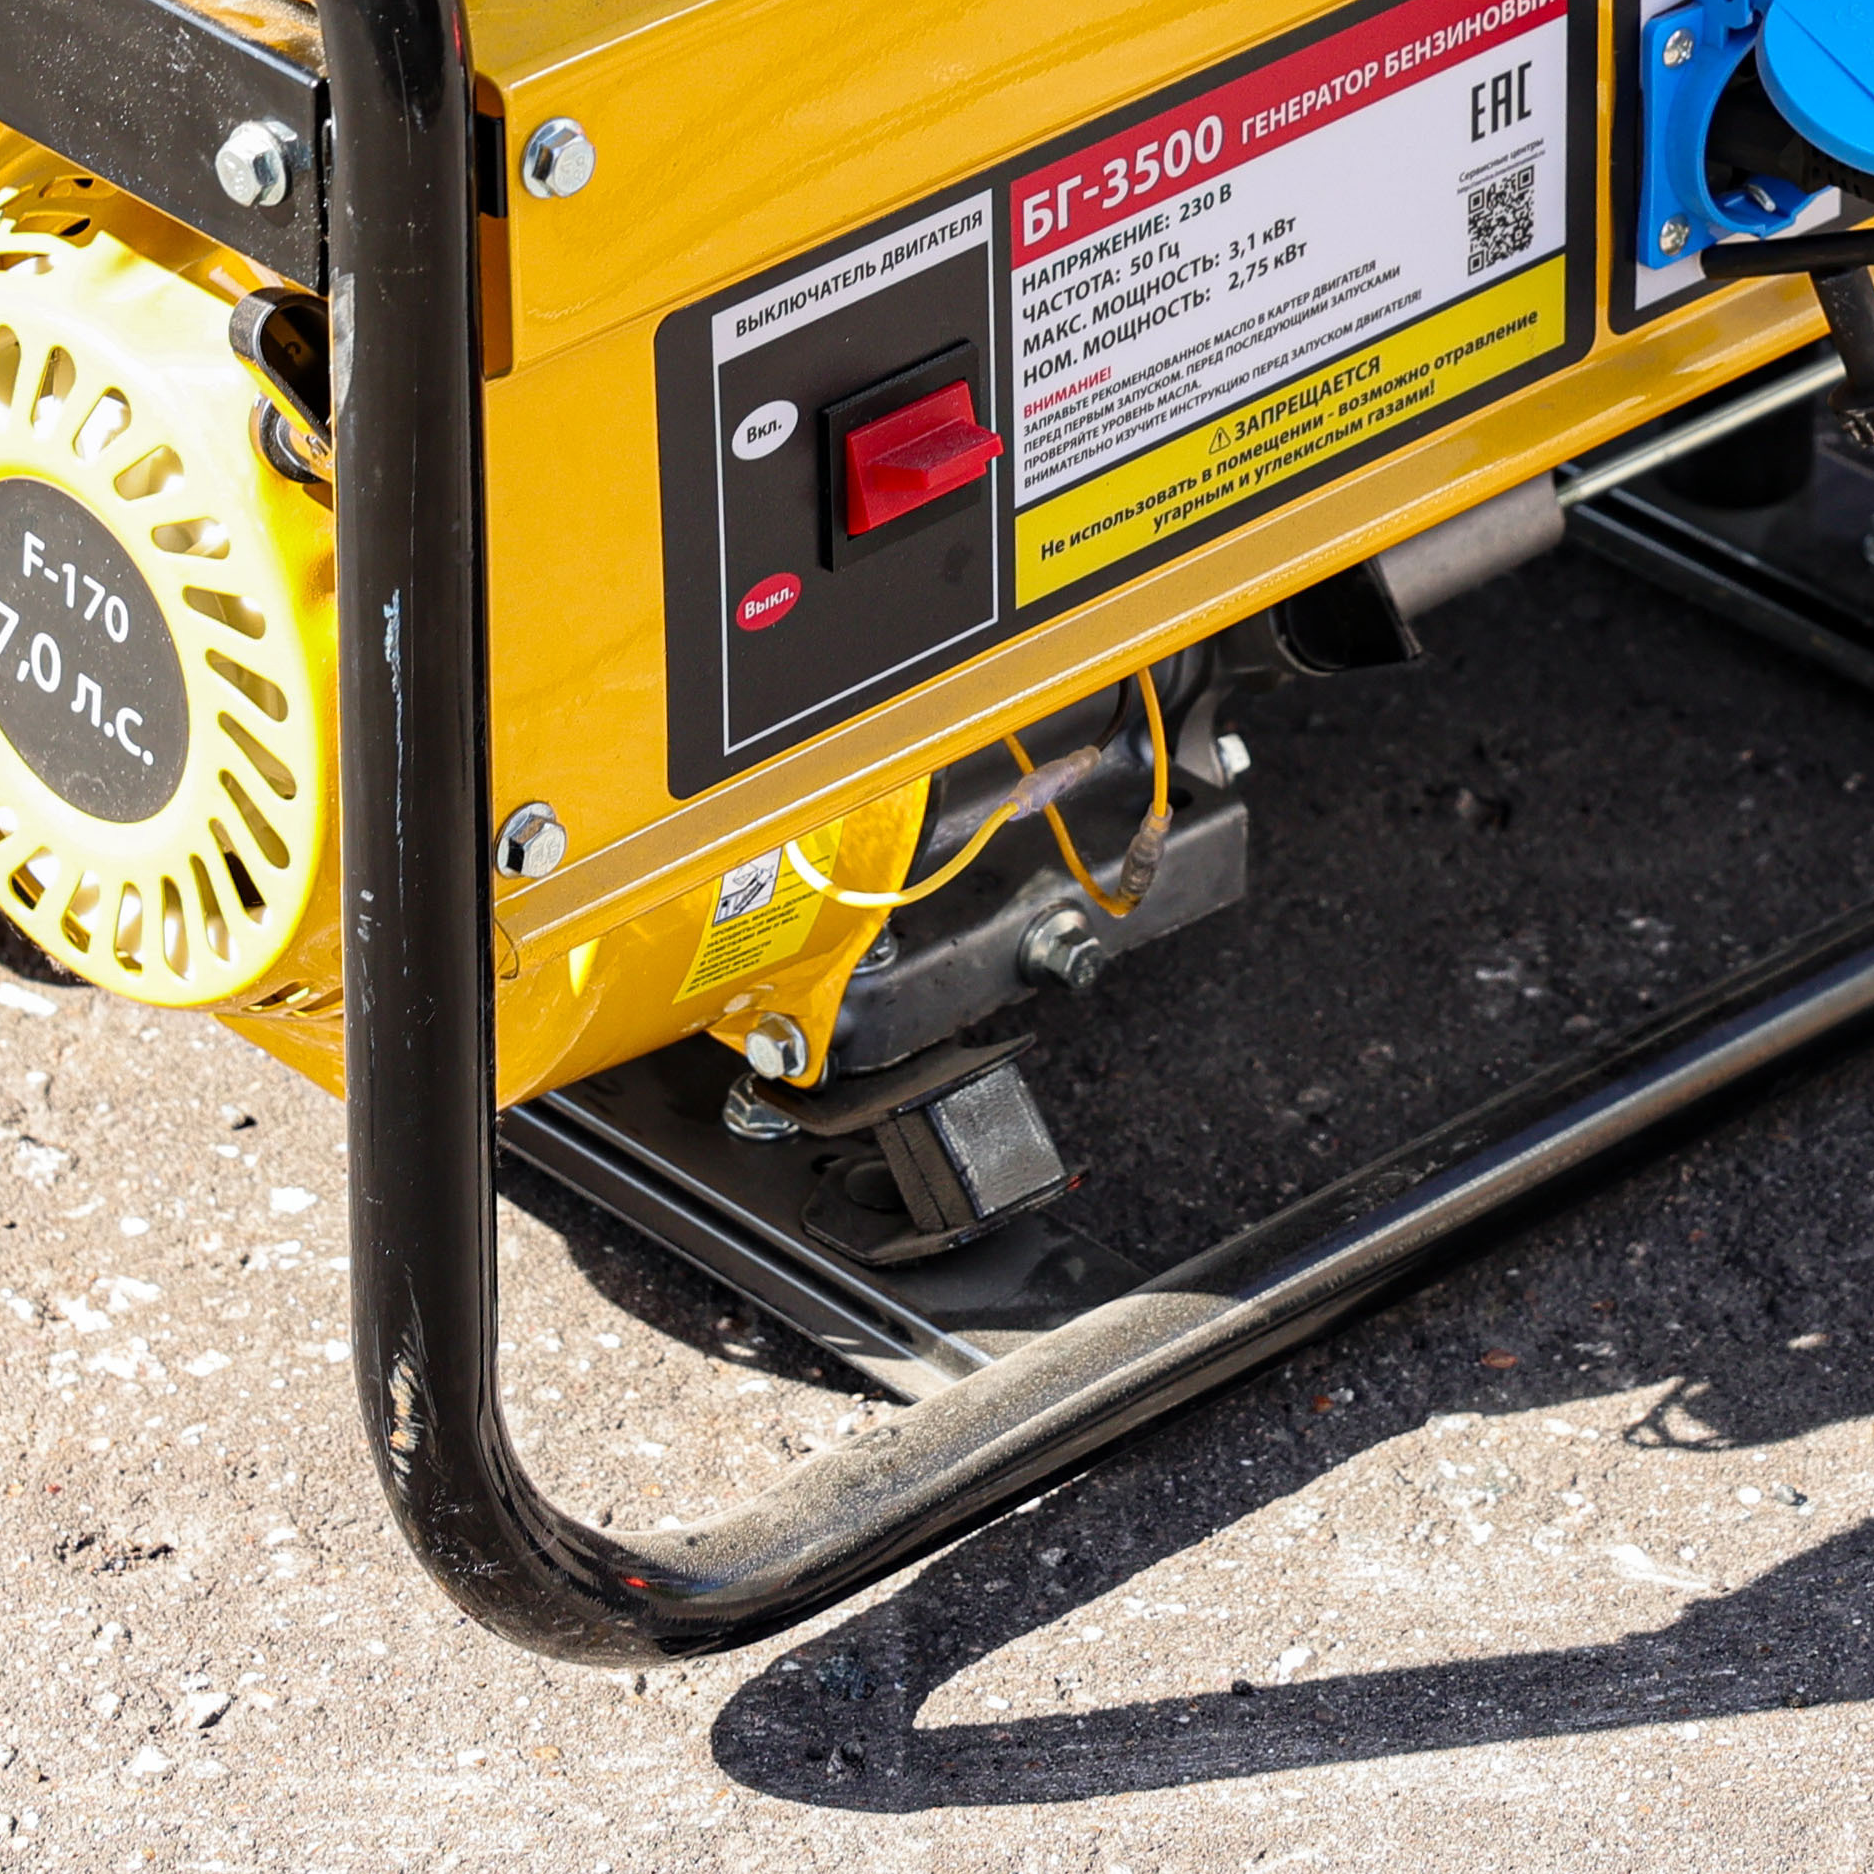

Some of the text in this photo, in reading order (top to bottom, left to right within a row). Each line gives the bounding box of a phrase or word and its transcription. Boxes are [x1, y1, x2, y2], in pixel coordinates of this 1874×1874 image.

[1023, 115, 1223, 246] БГ-3500
[1241, 62, 1379, 144] ГЕНЕРАТОР
[736, 210, 983, 338] ВЫКЛЮЧАТЕЛЬ ДВИГАТЕЛЯ
[1022, 183, 1232, 295] НАПРЯЖЕНИЕ: 230 В
[1022, 241, 1180, 324] ЧАСТОТА: 50 Гц
[1022, 215, 1297, 358] МАКС. МОЩНОСТЬ: 3,1 кВт
[1023, 241, 1308, 388] НОМ. МОЩНОСТЬ: 2,75 кВт
[1024, 259, 1376, 436] ЗАПРАВЬТЕ РЕКОМЕНДОВАННОЕ МАСЛО В КАРТЕР ДВИГАТЕЛЯ
[1024, 265, 1401, 453] ПЕРЕД ПЕРВЫМ ЗАПУСКОМ. ПЕРЕД ПОСЛЕДУЮЩИМИ ЗАПУСКАМИ
[747, 420, 782, 443] Вкл.
[1023, 366, 1112, 419] ВНИМАНИЕ!
[1024, 289, 1422, 489] ВНИМАТЕЛЬНО ИЗУЧИТЕ ИНСТРУКЦИЮ ПЕРЕД ЗАПУСКОМ ДВИГАТЕЛЯ!
[1024, 381, 1202, 471] ПРОВЕРЯЙТЕ УРОВЕНЬ МАСЛА.
[1041, 539, 1065, 561] Не
[1069, 473, 1198, 549] использовать
[1201, 468, 1212, 484] в
[1217, 416, 1325, 479] помещении
[1338, 364, 1430, 419] возможно
[1433, 310, 1539, 374] отравление
[1234, 355, 1381, 441] ЗАПРЕЩАЕТСЯ
[1152, 380, 1436, 534] угарным и углекислым газами!
[23, 531, 129, 643] F-170
[745, 585, 794, 619] Выкл.
